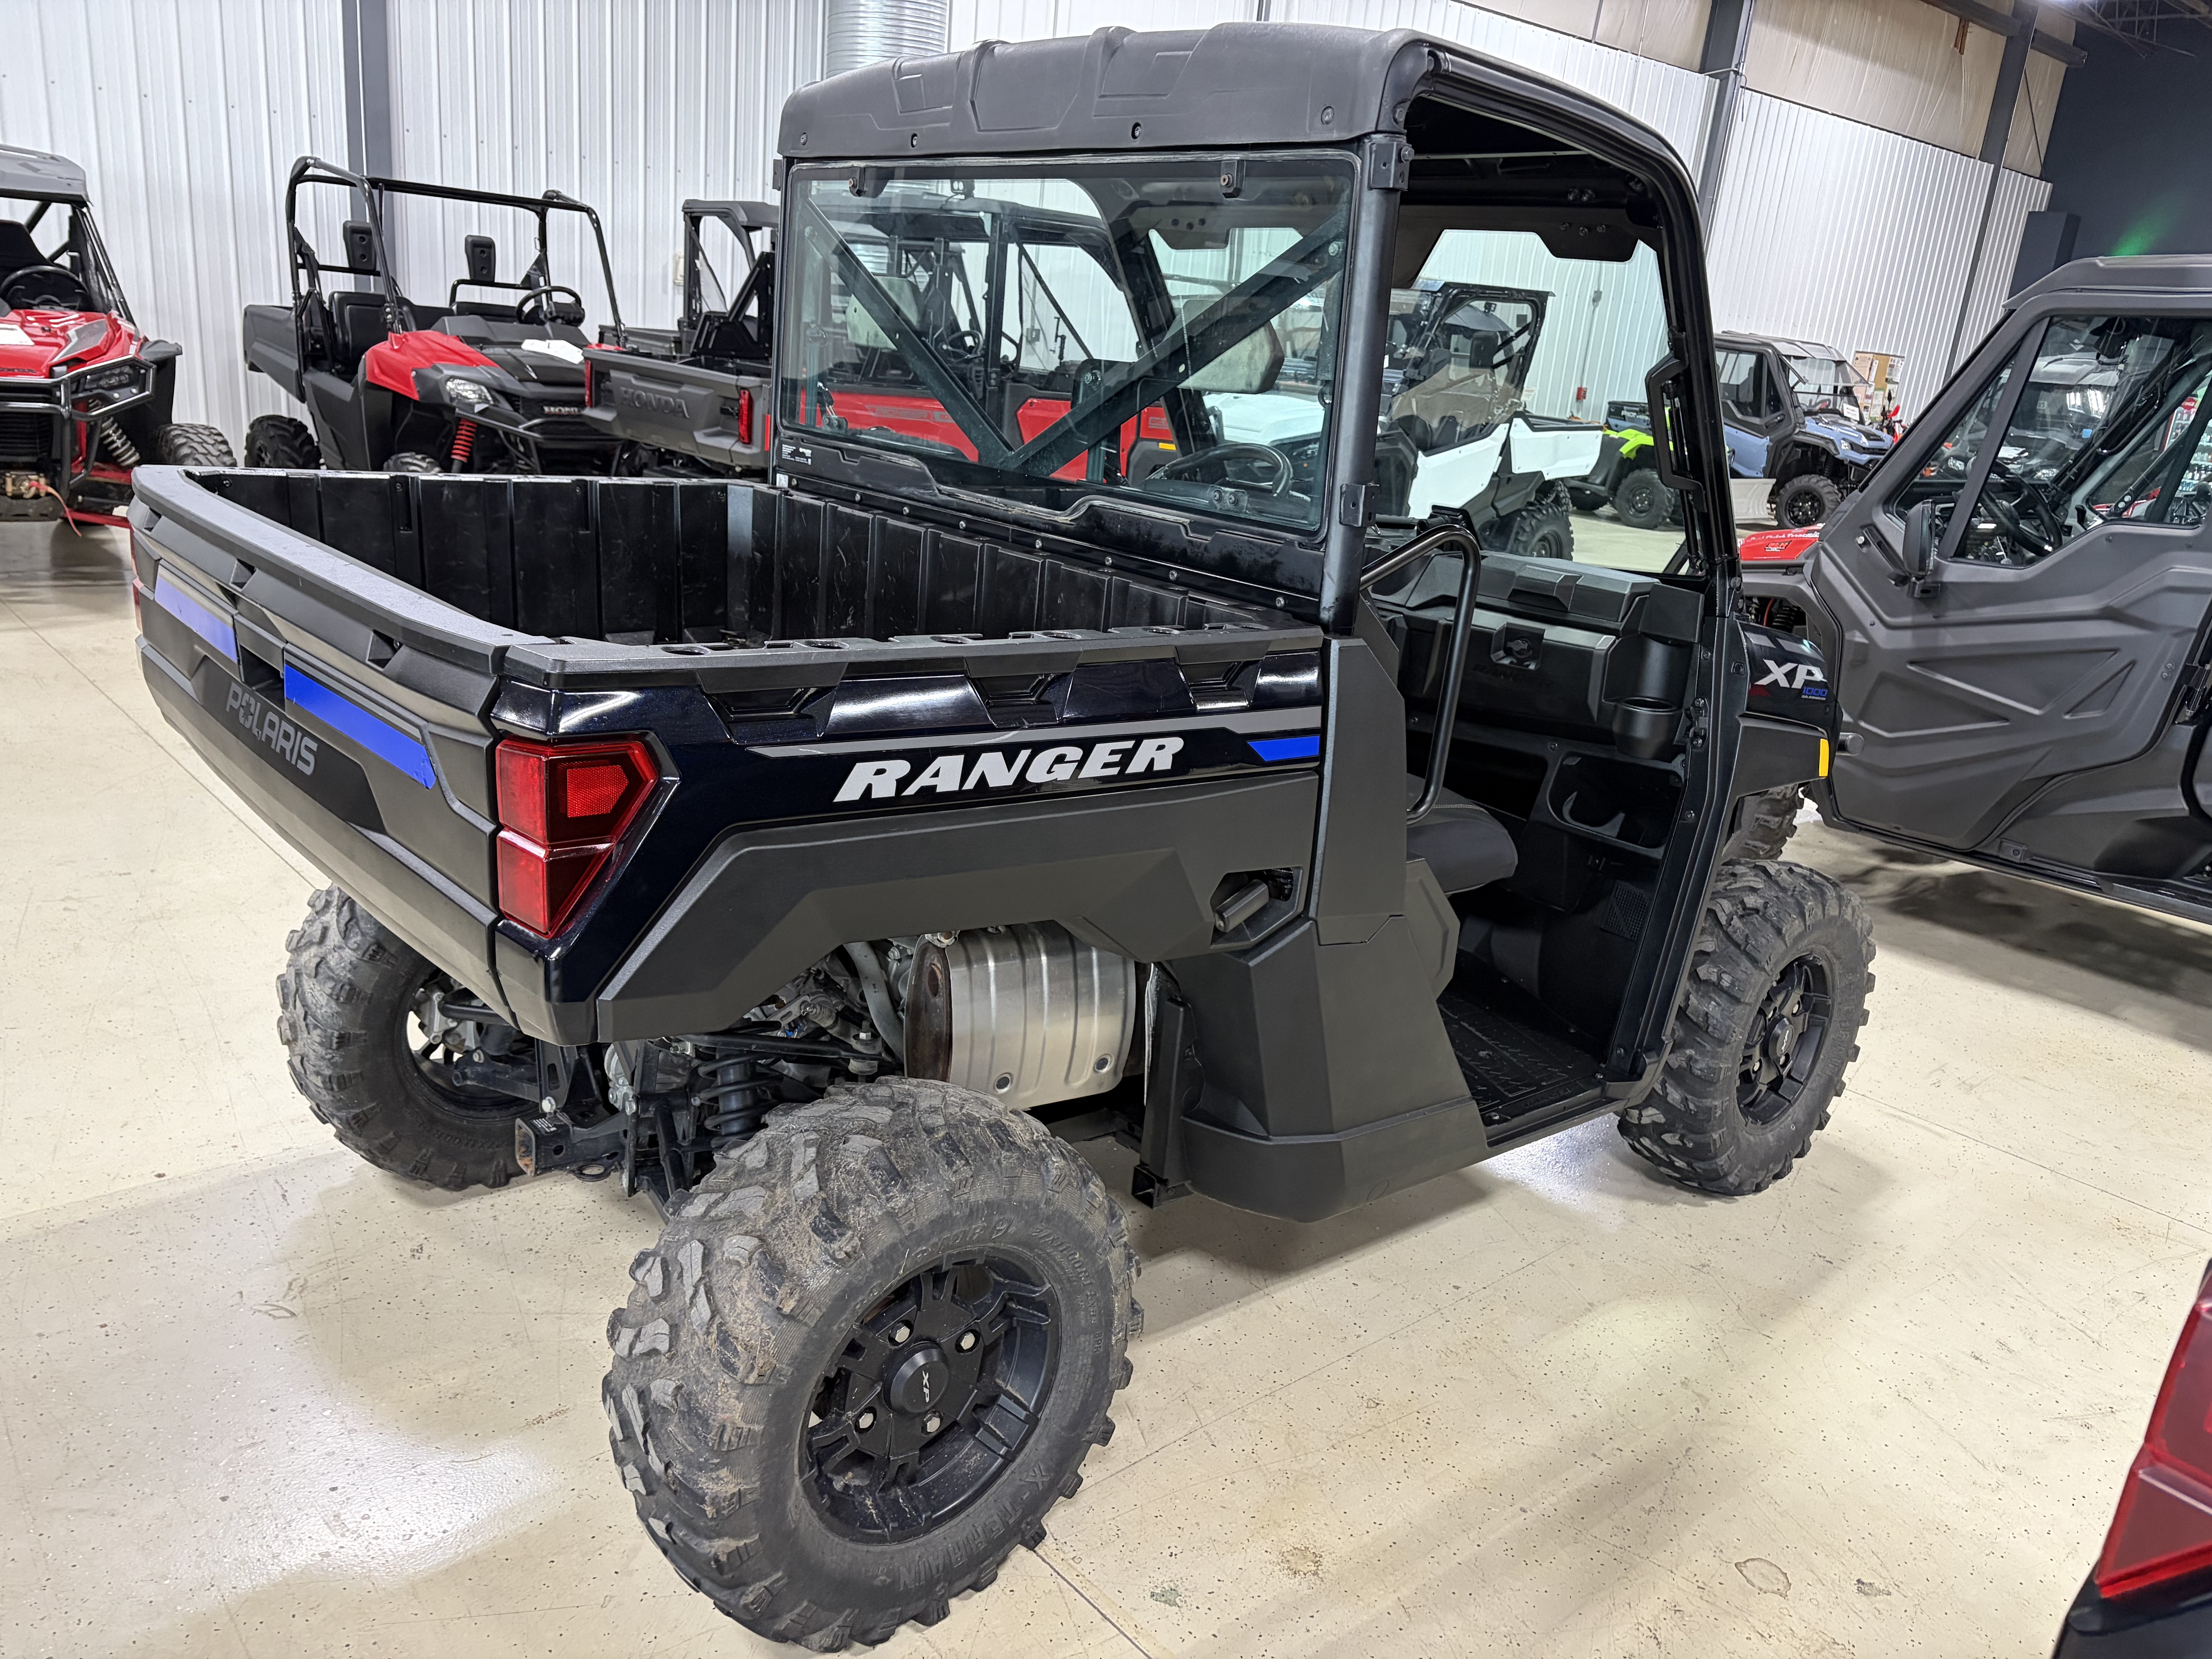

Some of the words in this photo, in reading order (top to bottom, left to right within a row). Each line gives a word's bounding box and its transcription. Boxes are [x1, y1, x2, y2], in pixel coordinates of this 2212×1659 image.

[620, 387, 690, 418] HONDA
[1754, 659, 1828, 689] XP
[1803, 687, 1828, 697] 1000
[226, 681, 318, 776] POLARIS
[833, 737, 1184, 803] RANGER
[1094, 1331, 1103, 1354] 8PR
[922, 1370, 929, 1403] XP
[898, 1463, 1053, 1591] X-TERRAIN
